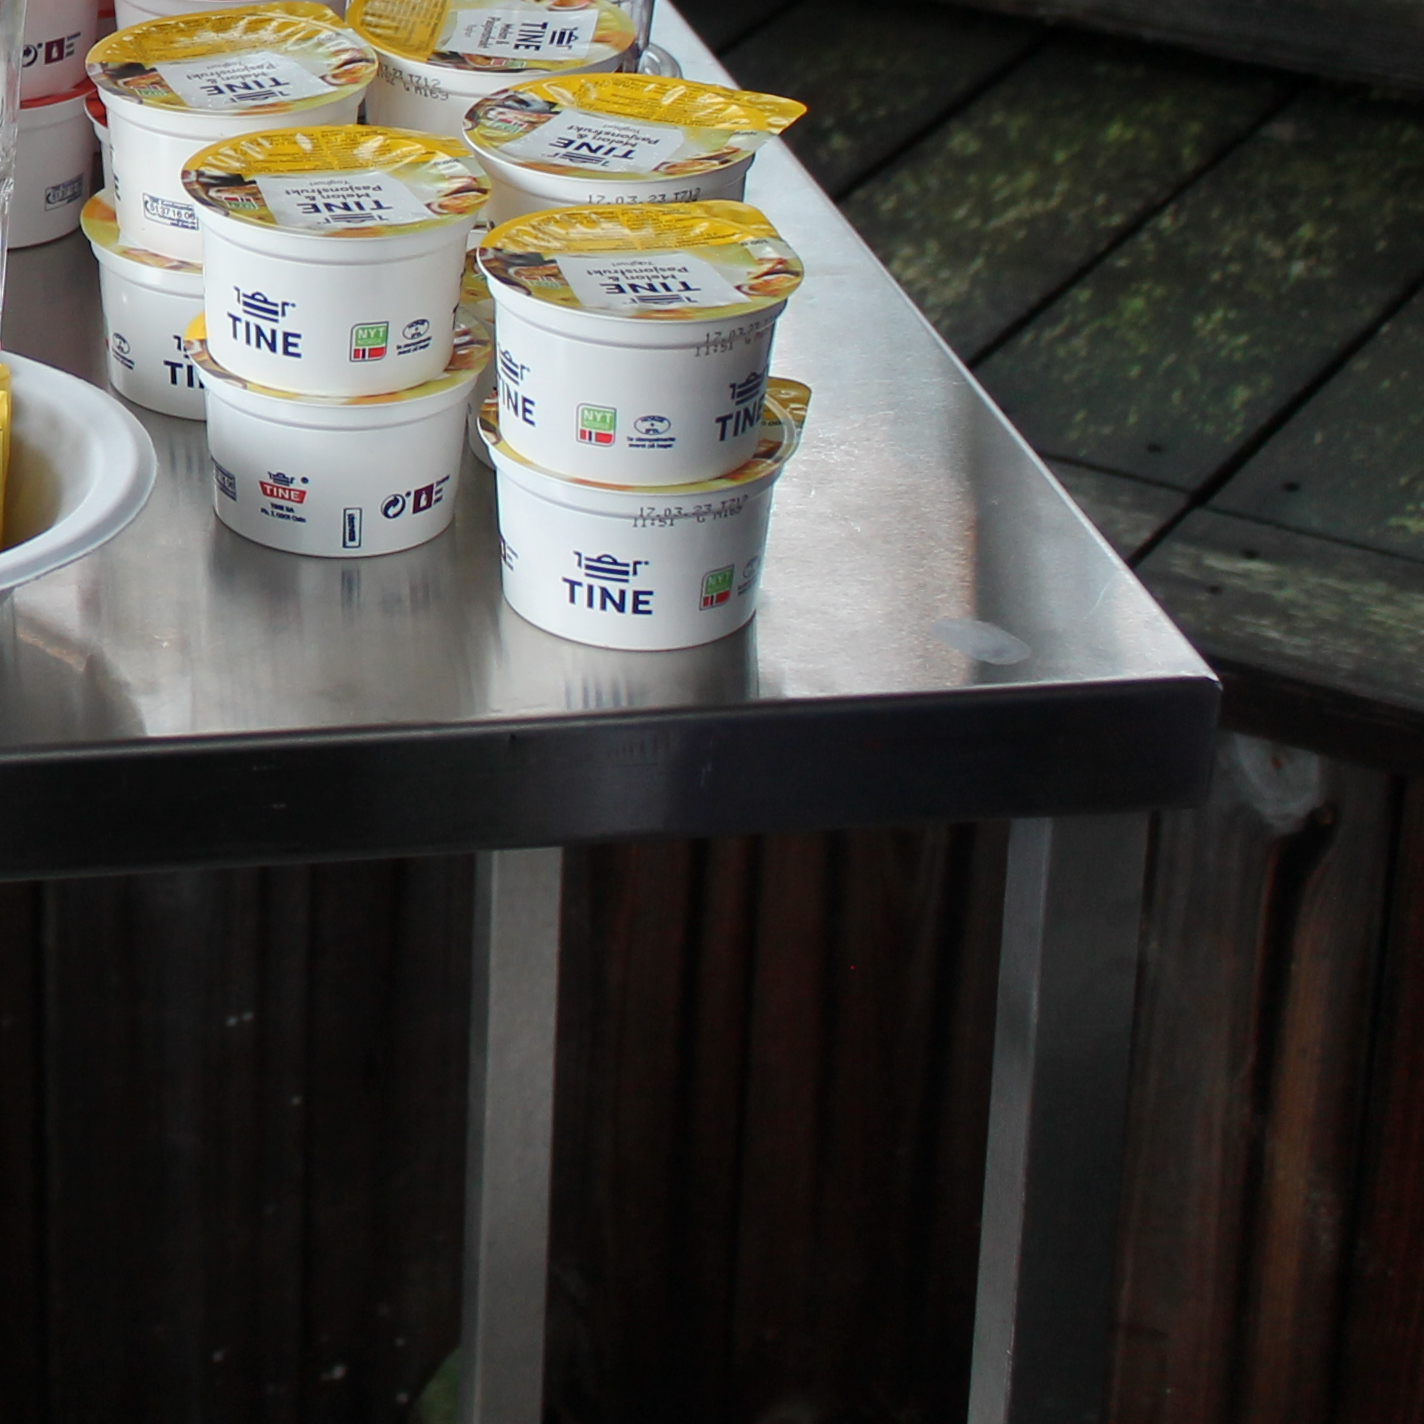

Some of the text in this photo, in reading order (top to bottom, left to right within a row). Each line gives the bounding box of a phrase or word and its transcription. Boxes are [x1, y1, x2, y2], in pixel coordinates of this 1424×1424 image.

[513, 22, 549, 52] TINE
[200, 77, 290, 96] TINE
[567, 125, 660, 145] Pasjonsfrukt
[549, 138, 638, 160] TINE
[285, 185, 383, 197] Pasjonsfrukt
[296, 202, 394, 215] TINE
[587, 266, 689, 277] Pasjonsfrukt
[600, 283, 701, 295] TINE
[227, 312, 303, 359] TINE
[358, 327, 384, 339] NYT
[163, 360, 205, 389] TI
[583, 410, 613, 424] NYT
[264, 483, 301, 502] TINE
[632, 516, 676, 529] 11:51
[562, 577, 654, 615] TINE
